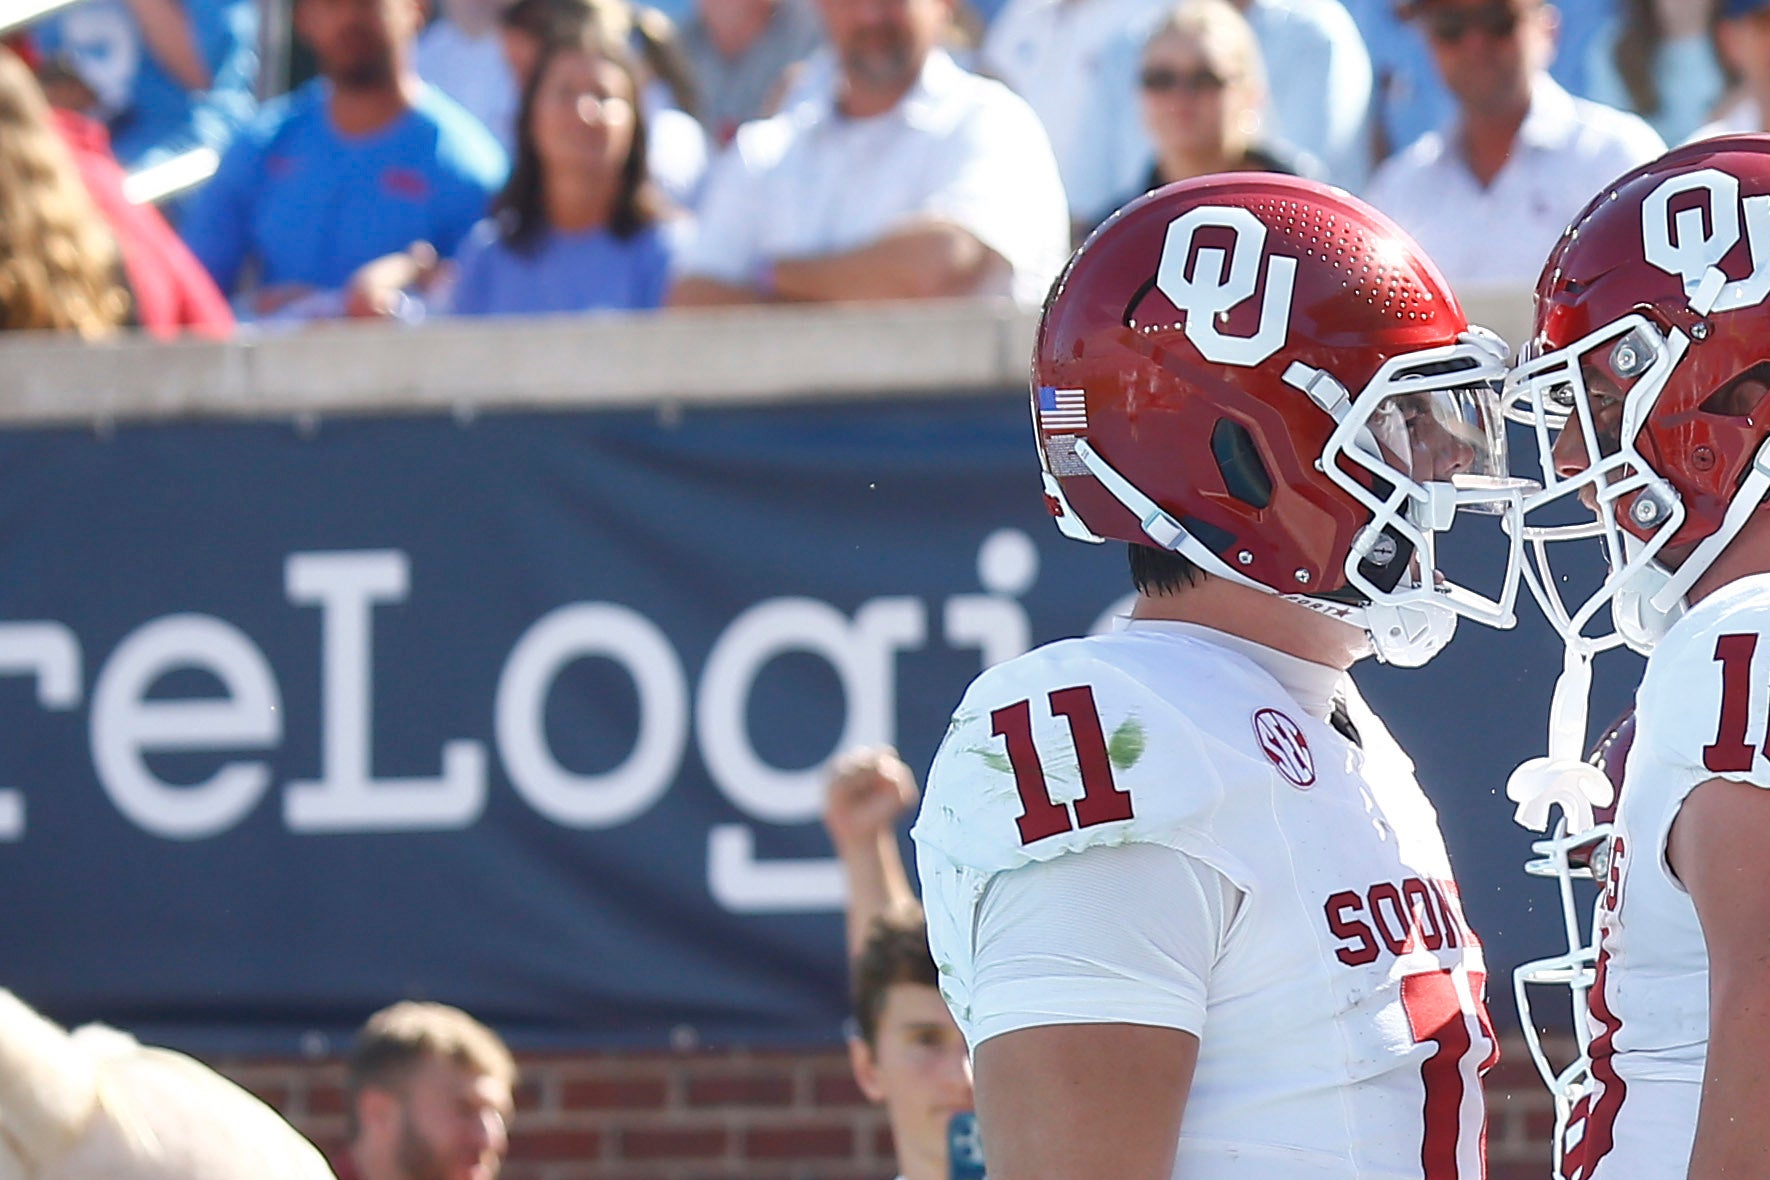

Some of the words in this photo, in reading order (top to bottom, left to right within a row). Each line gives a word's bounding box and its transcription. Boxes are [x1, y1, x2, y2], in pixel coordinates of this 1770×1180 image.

[1156, 204, 1298, 369] OU
[0, 528, 1136, 912] reLogi
[990, 685, 1134, 846] 11
[1255, 708, 1315, 787] SEC
